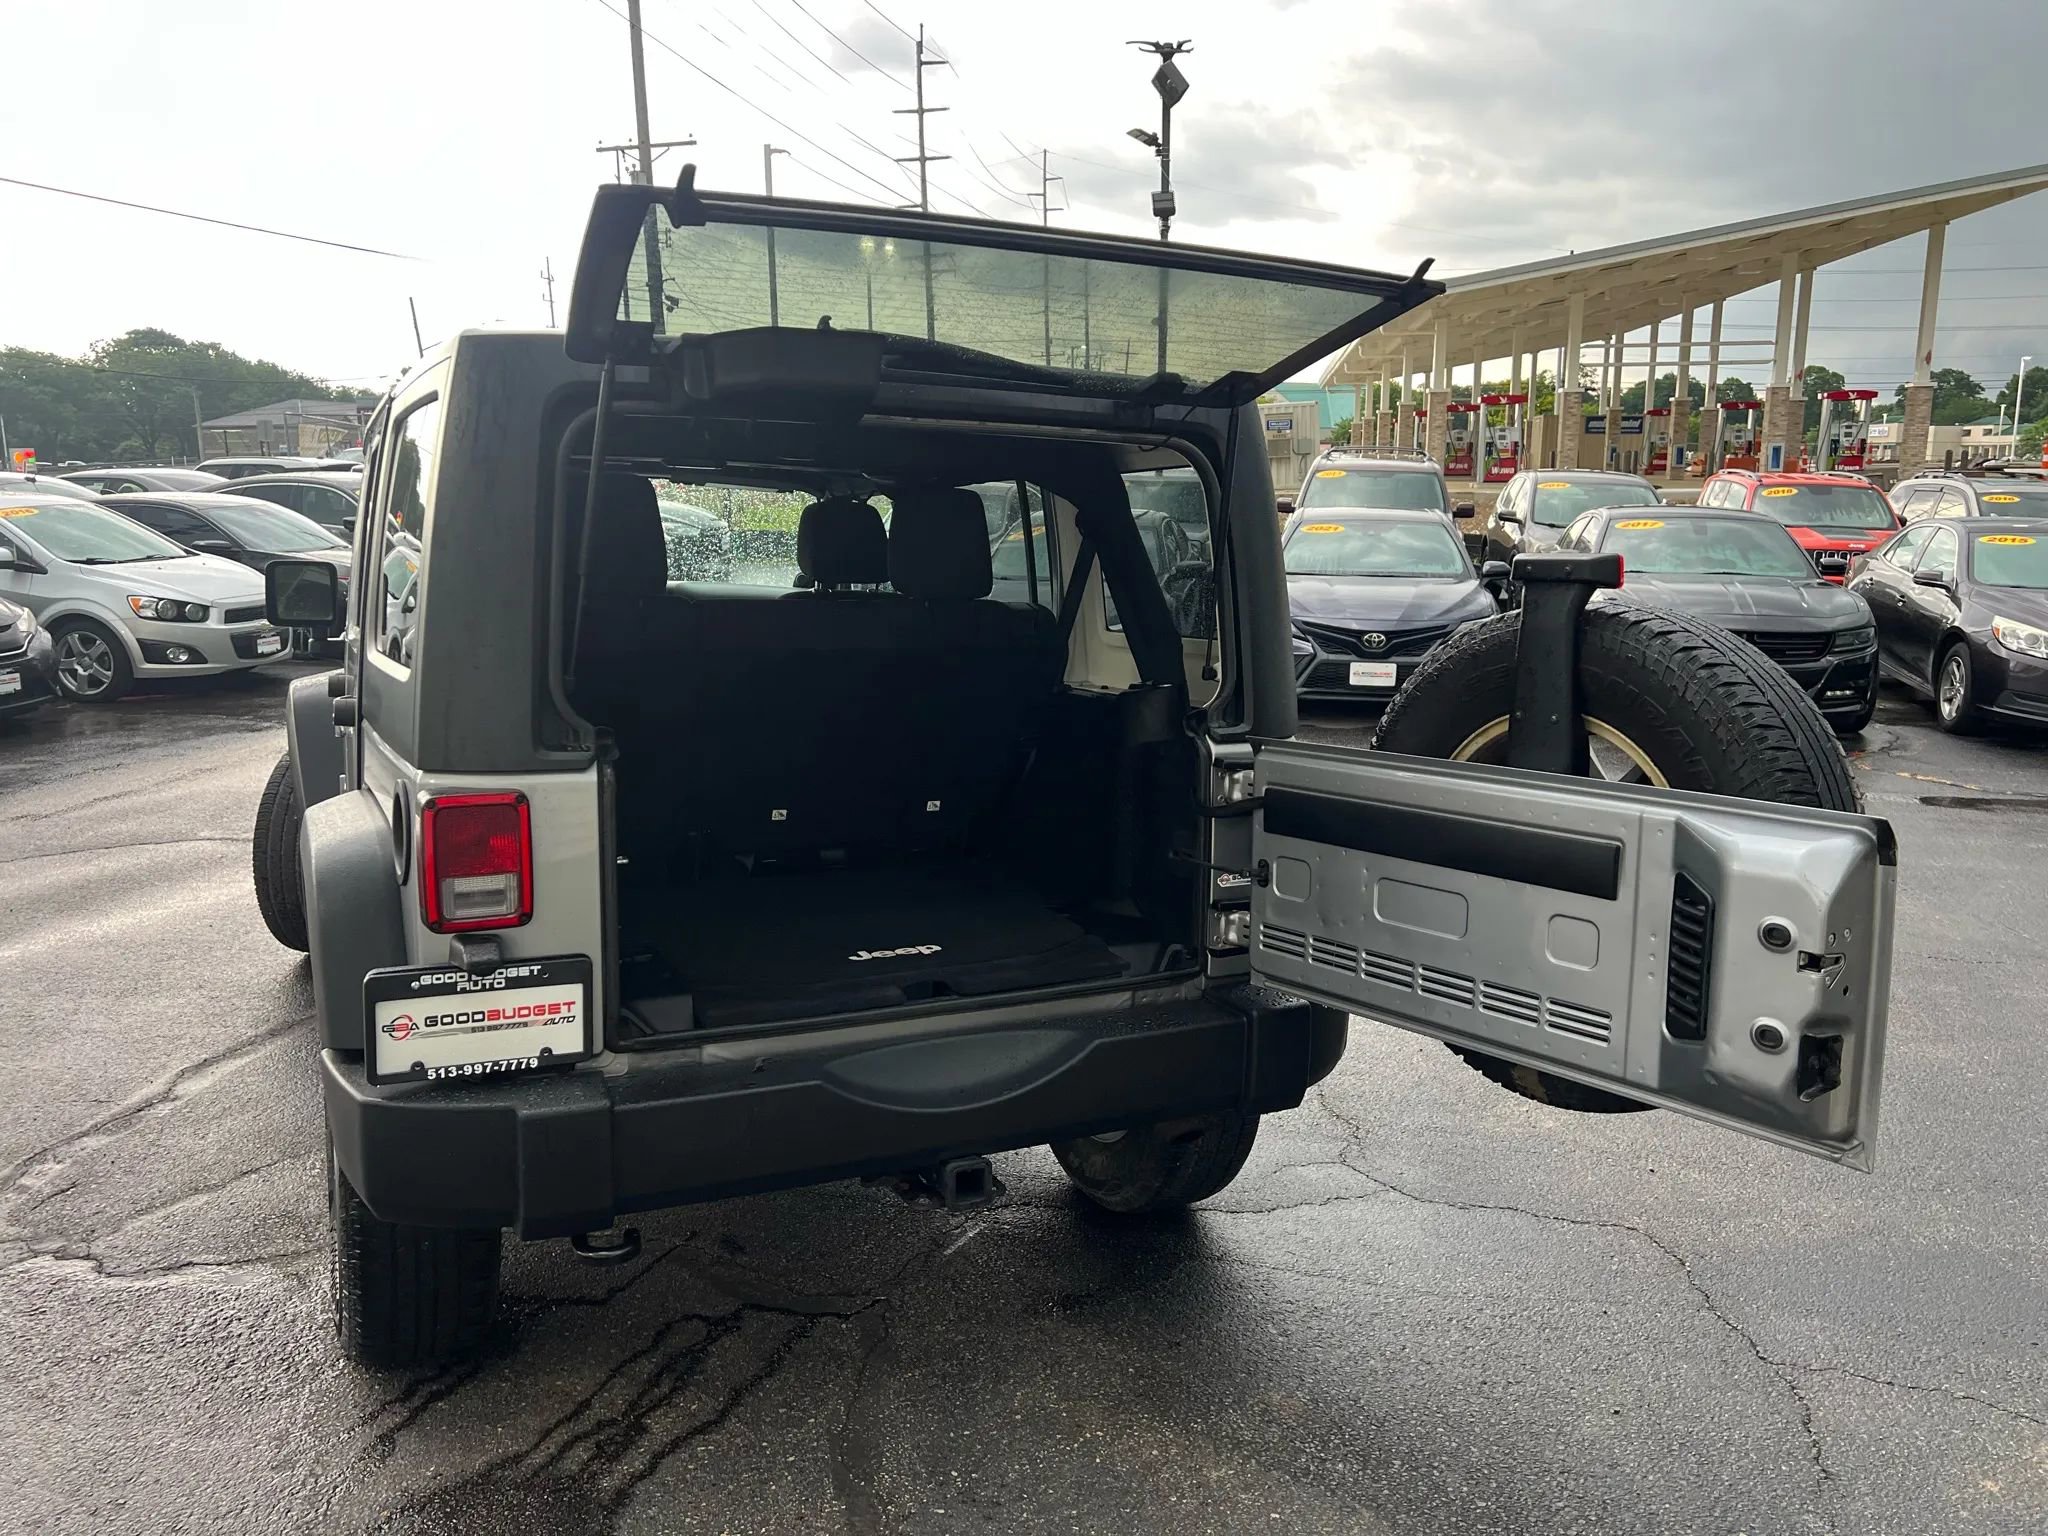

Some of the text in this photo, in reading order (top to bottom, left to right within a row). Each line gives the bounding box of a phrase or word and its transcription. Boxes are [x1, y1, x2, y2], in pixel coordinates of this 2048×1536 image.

[1491, 466, 1515, 474] Wawa
[848, 944, 942, 961] Jeep
[420, 972, 469, 986] GOOD
[456, 979, 506, 992] AUTO
[424, 1001, 576, 1028] GOODBUDGET
[542, 1015, 576, 1026] AUTO
[427, 1057, 539, 1080] 513-997-7779
